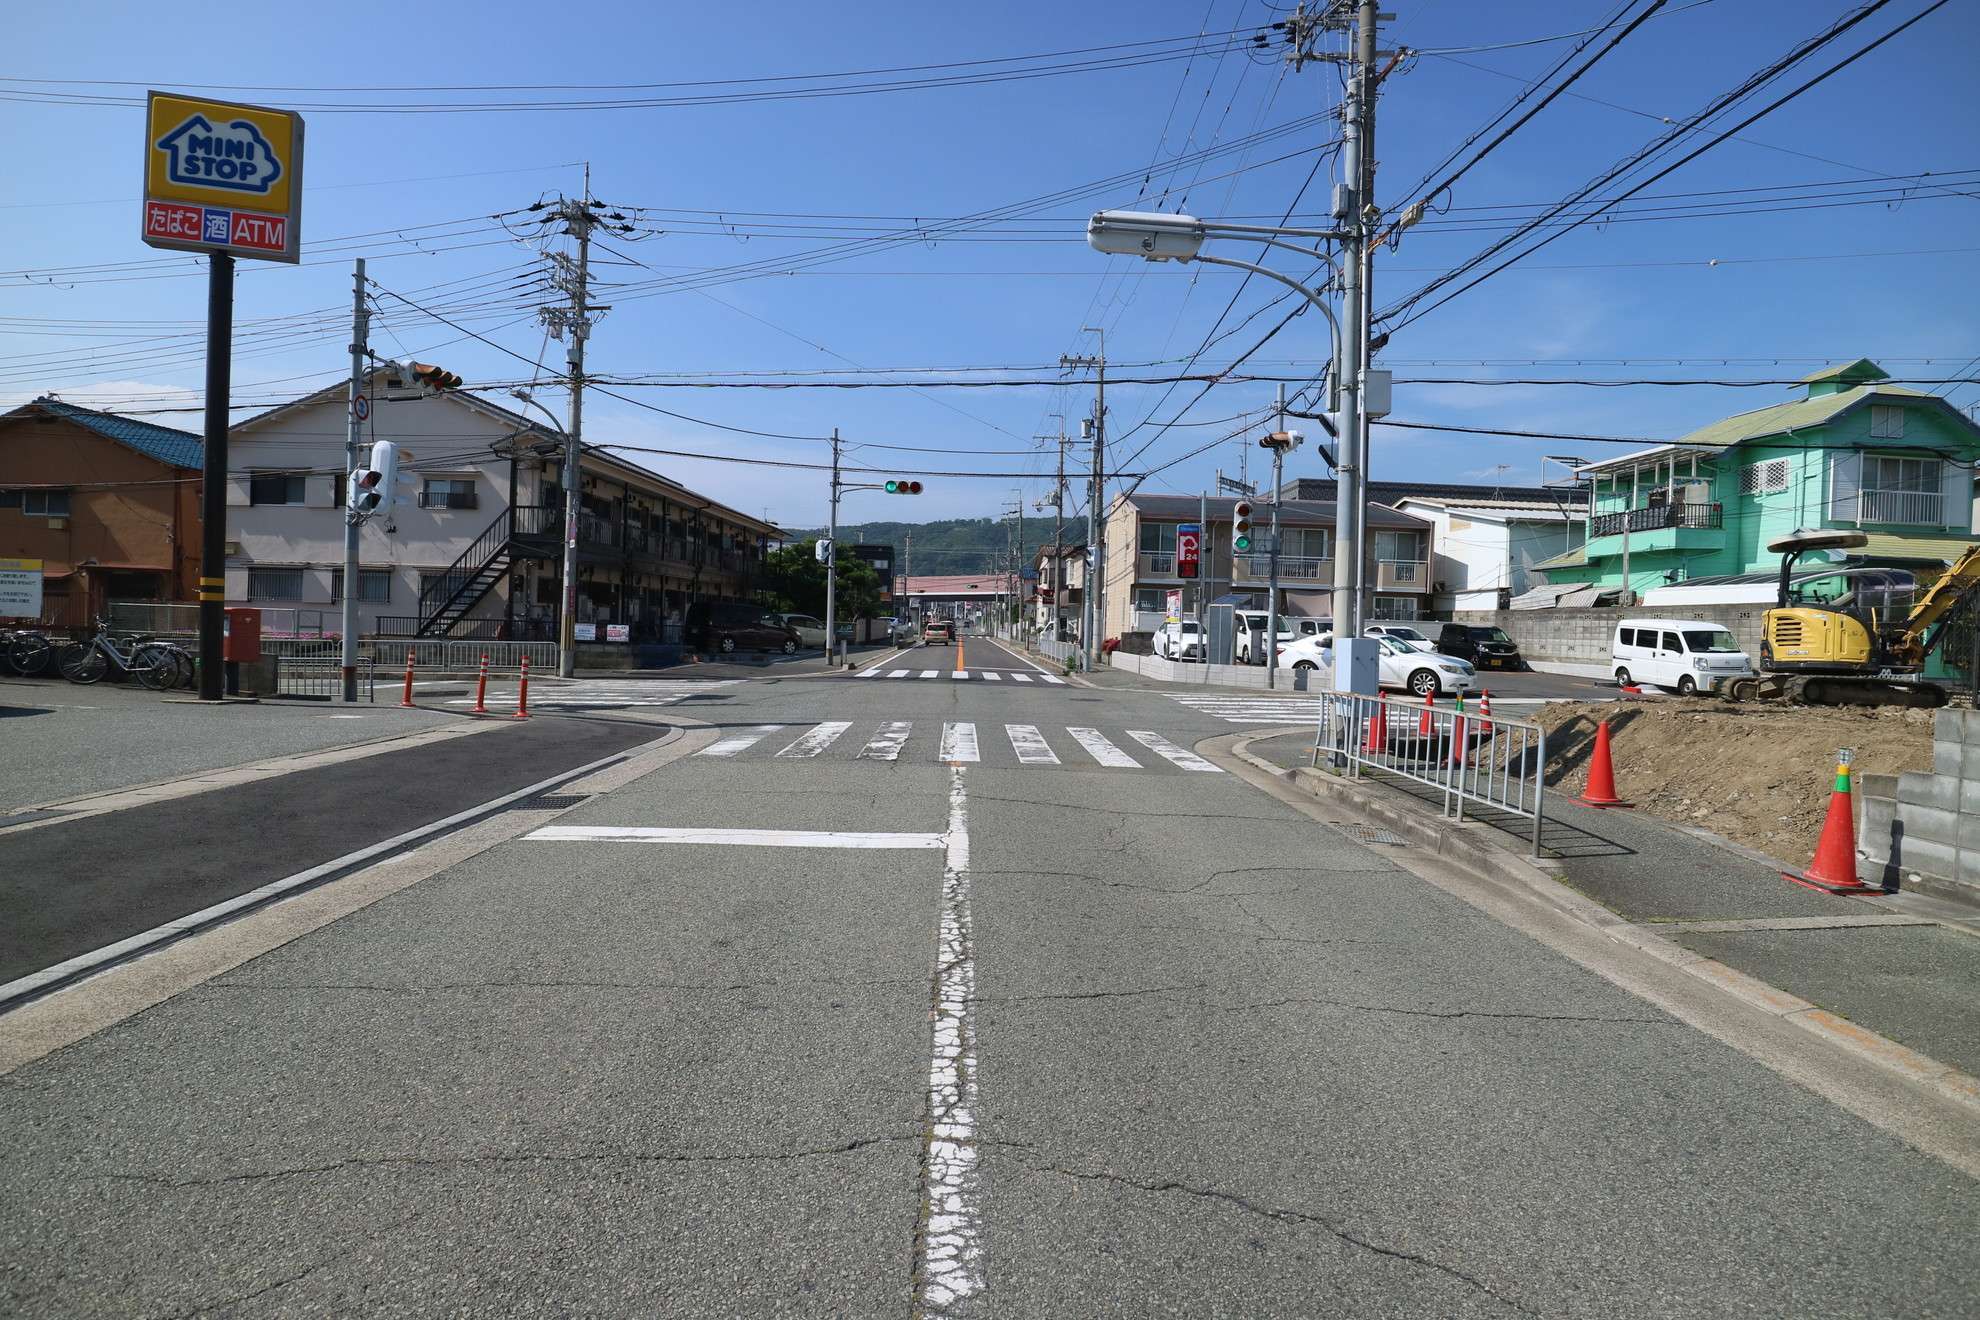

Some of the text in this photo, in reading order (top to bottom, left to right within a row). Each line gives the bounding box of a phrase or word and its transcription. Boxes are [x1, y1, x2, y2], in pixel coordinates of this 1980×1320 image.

[189, 134, 254, 160] MINI
[184, 155, 257, 181] STOP
[150, 207, 283, 245] たばこ 酒 ATM
